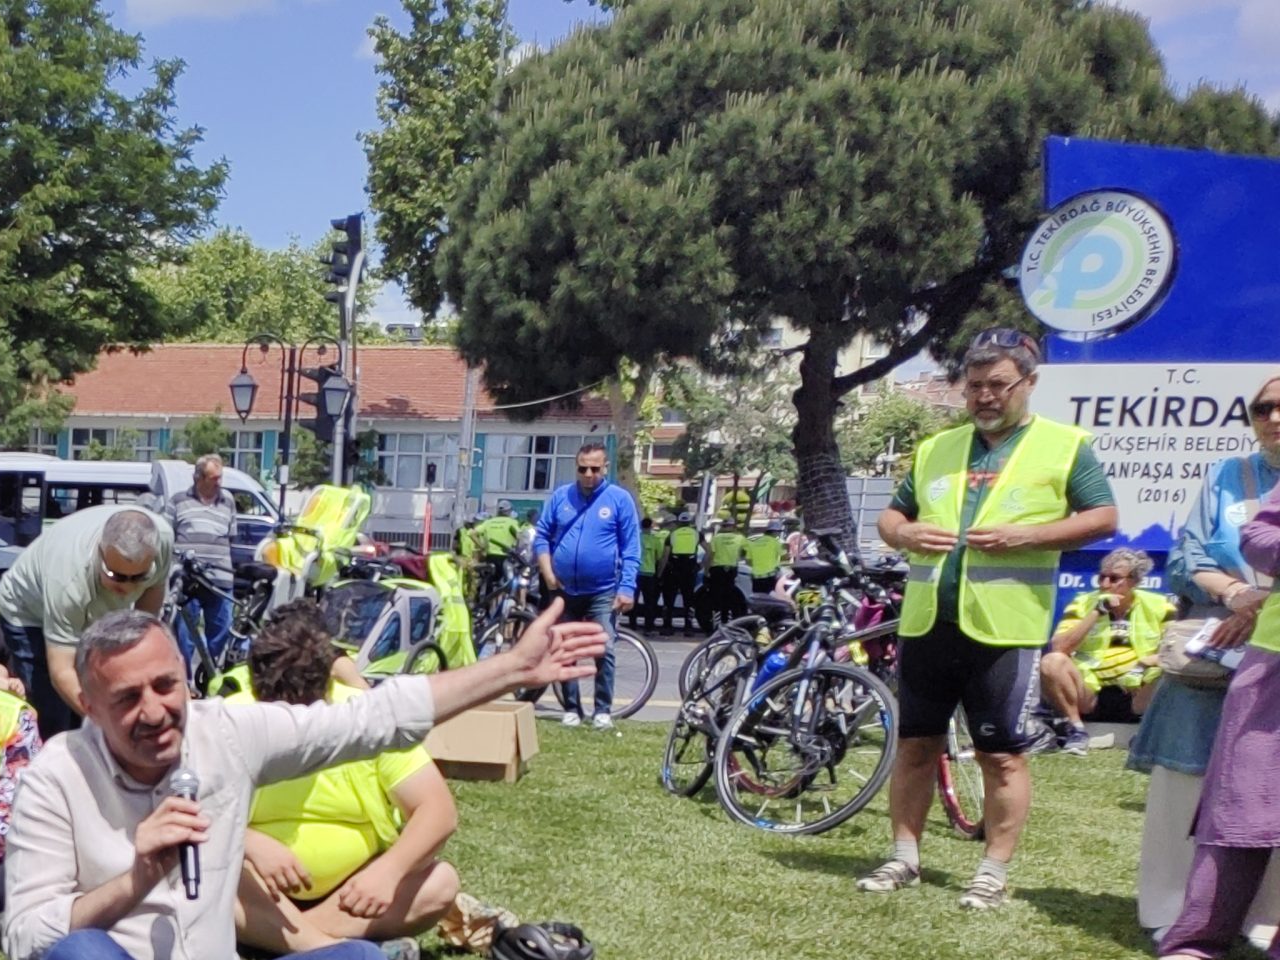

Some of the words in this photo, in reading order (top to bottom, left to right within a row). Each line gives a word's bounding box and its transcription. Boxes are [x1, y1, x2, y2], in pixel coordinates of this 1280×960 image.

[1036, 200, 1101, 248] TEKİRDAĞ
[1105, 200, 1165, 265] BÜYÜKŞEHİR
[1092, 268, 1157, 326] BELEDİYESİ
[1166, 368, 1201, 385] T.C.
[1069, 386, 1252, 427] TEKİRDA
[1091, 433, 1177, 455] YÜKŞEHİR
[1184, 433, 1259, 451] BELEDİY
[1137, 487, 1187, 504] (2016)
[1058, 572, 1086, 588] Dr.
